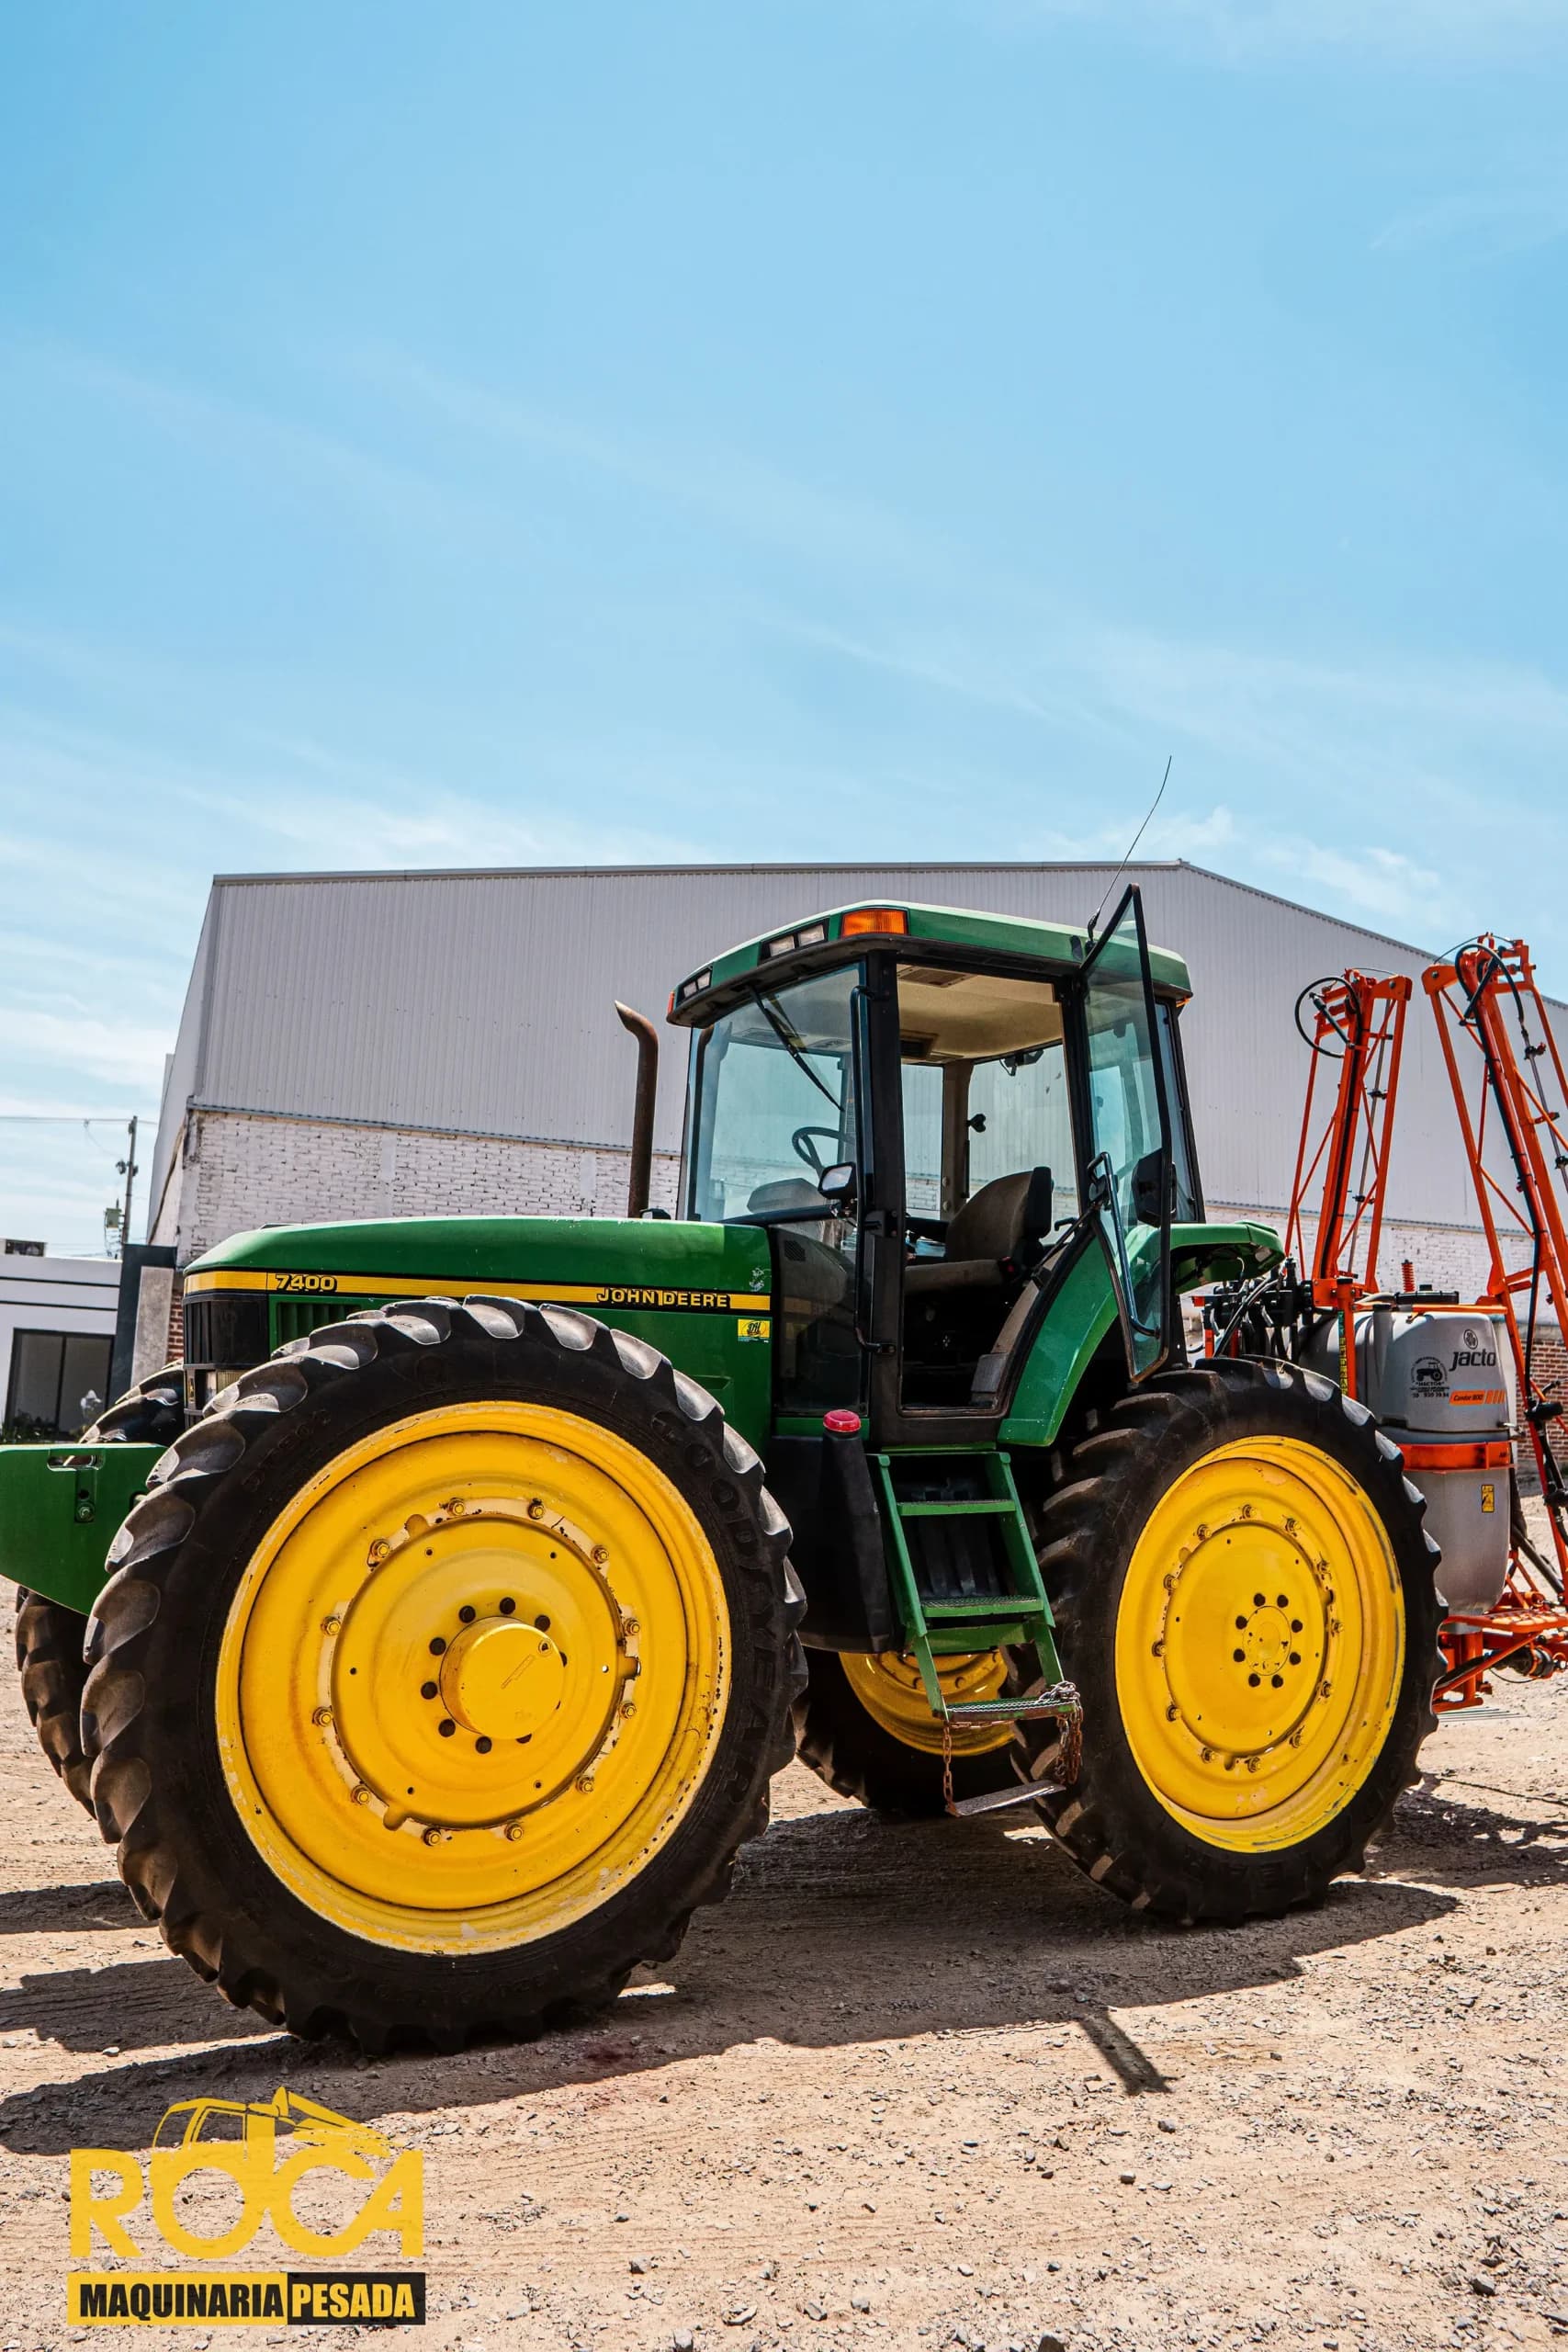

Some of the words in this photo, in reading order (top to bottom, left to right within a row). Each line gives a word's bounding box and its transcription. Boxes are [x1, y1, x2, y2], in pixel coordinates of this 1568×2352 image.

[276, 1274, 335, 1291] 7400
[598, 1288, 656, 1305] JOHN
[663, 1292, 728, 1308] DEERE
[1449, 1348, 1496, 1372] jacto
[650, 1409, 777, 1803] GOODYEAR
